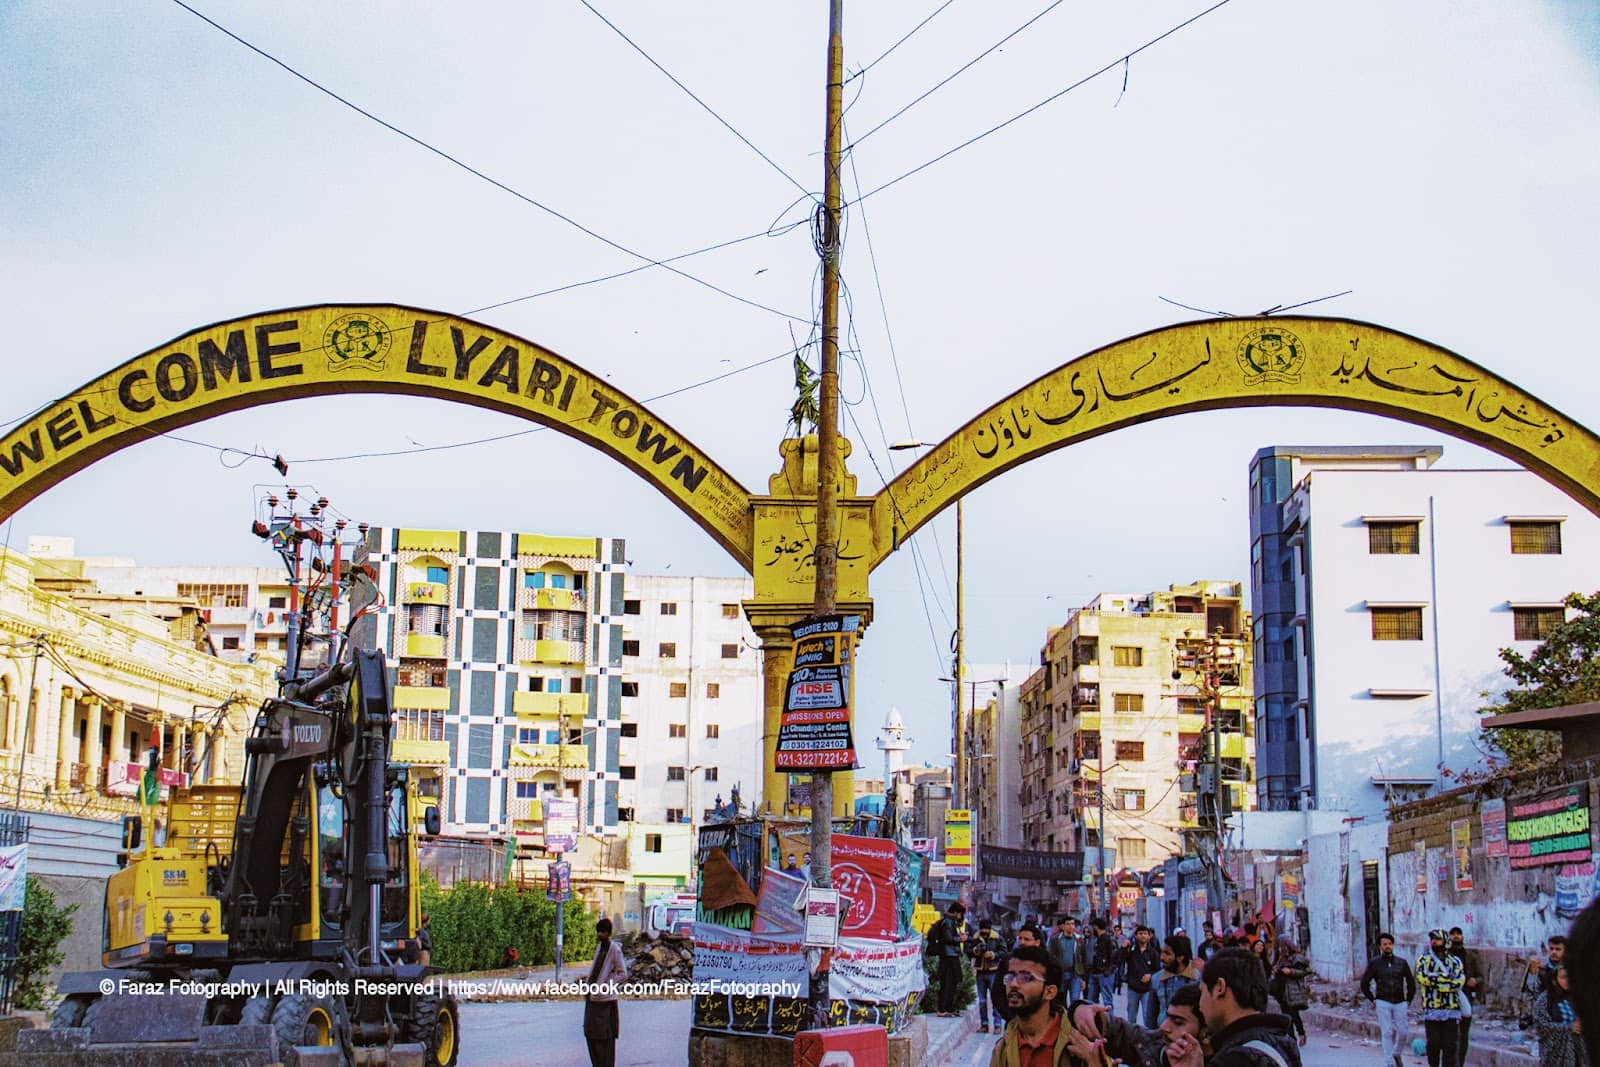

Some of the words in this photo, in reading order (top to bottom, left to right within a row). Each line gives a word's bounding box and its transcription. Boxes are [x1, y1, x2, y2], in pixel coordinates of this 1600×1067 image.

[1034, 336, 1211, 425] لیاری
[1330, 337, 1480, 412] آمدید
[1, 320, 304, 477] WELCOME
[406, 319, 579, 412] LYARI
[591, 390, 708, 494] TOWN
[973, 404, 1032, 459] ٹاؤن
[1477, 391, 1565, 448] خوش
[294, 725, 322, 743] VOLVO
[840, 872, 863, 893] 27
